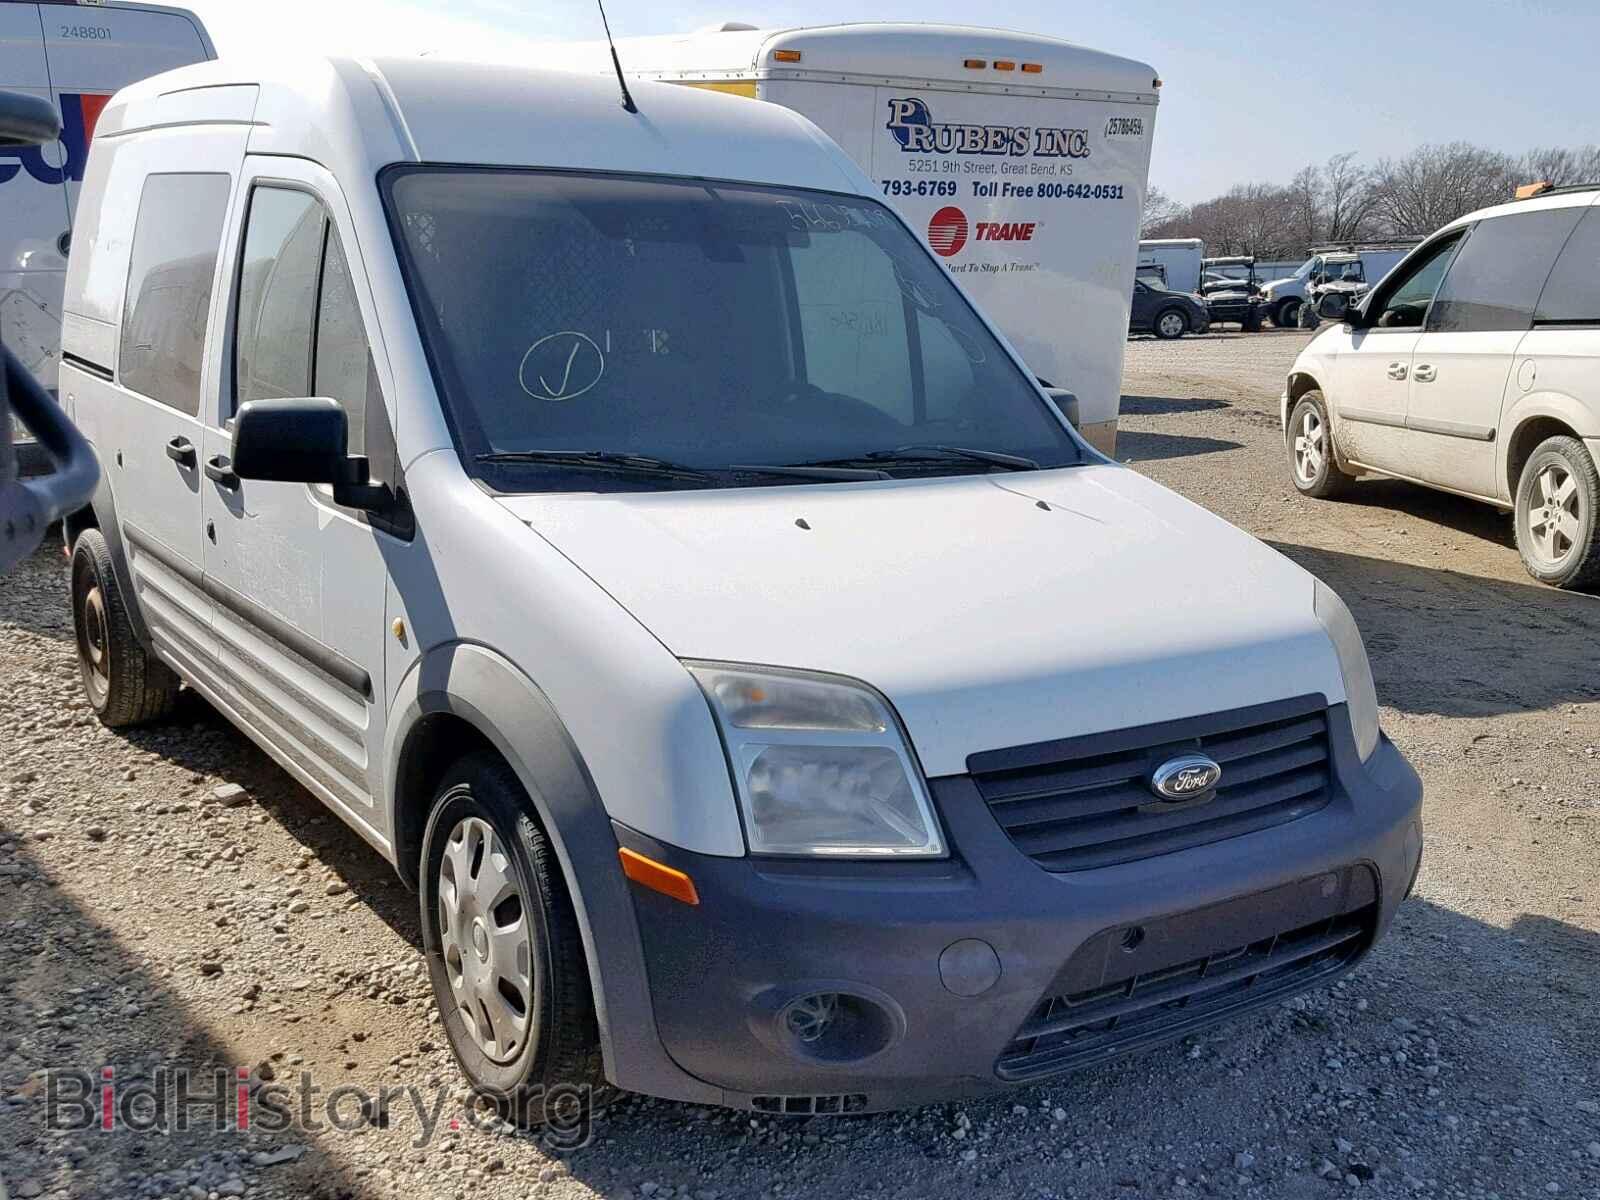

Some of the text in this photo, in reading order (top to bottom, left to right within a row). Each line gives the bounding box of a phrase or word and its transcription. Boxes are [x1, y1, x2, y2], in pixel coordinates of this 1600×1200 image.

[60, 25, 112, 40] 248801
[902, 123, 1090, 158] RUBE'S INC.
[908, 159, 1073, 176] 5251 9th Street, Great Bend, KS
[881, 180, 1124, 199] 793-6769 Toll Free 800-642-0531
[976, 223, 1036, 240] TRANE
[968, 263, 979, 273] To
[980, 263, 1000, 275] Stop
[1175, 768, 1208, 791] Ford
